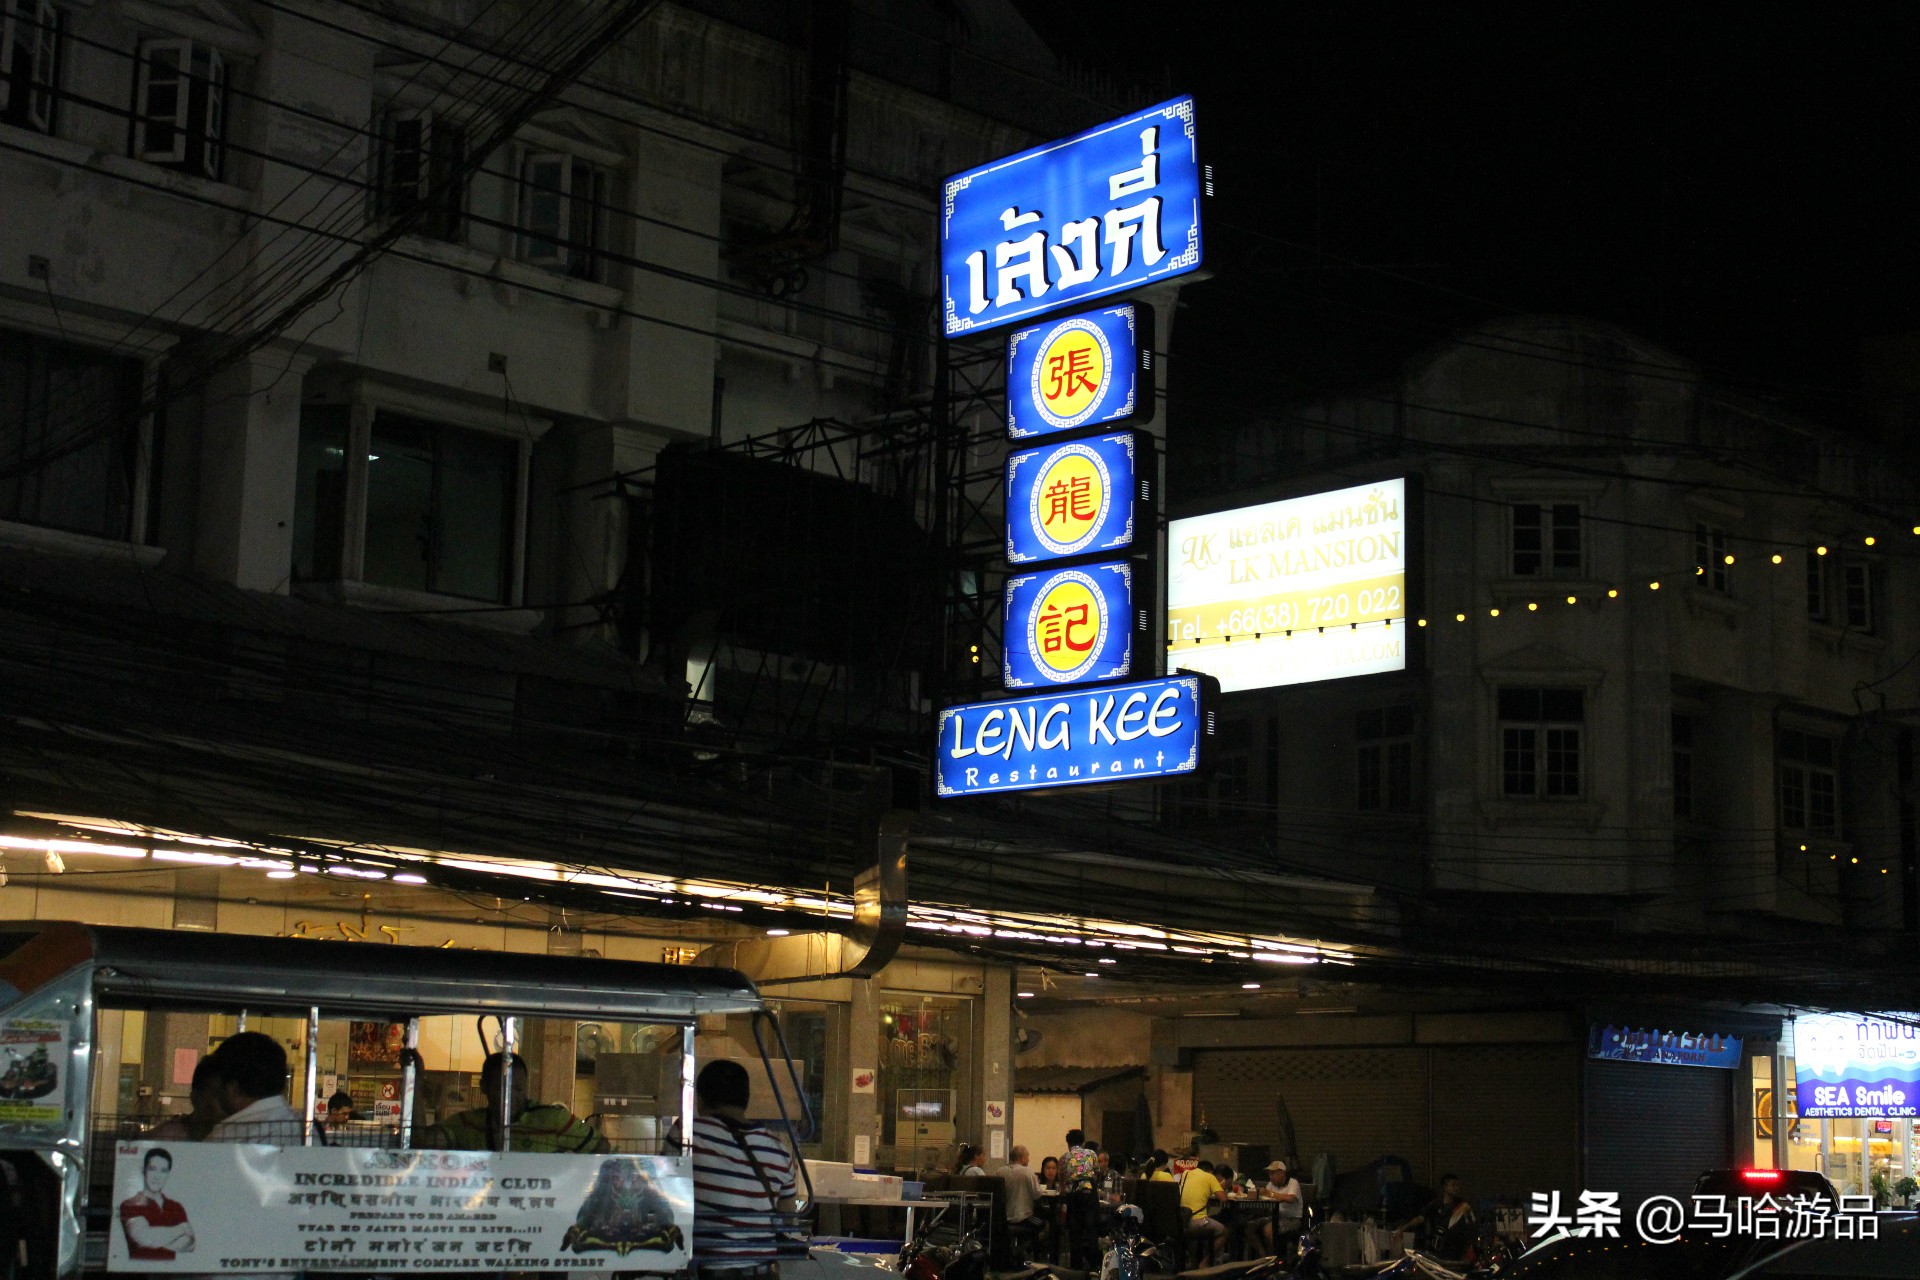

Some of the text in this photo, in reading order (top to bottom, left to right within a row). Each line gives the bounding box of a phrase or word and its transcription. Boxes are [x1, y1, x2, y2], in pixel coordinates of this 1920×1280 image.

[1039, 347, 1099, 653] 張 龍 記
[1228, 531, 1401, 585] LK MANSION
[1170, 585, 1401, 641] Tel. +66(38) 720 022
[951, 688, 1182, 760] LENG KEE
[966, 751, 1164, 787] Restaurant
[1814, 1084, 1906, 1106] SEA Smile
[1804, 1106, 1917, 1117] AESTHETICS DENTAL CLINIC
[294, 1172, 552, 1190] INCREDIBLE INDIAN CLUB
[409, 1212, 425, 1220] TO
[219, 1258, 606, 1270] TONY'S ENTERTAINMENT COMPLEX WALKING STREET
